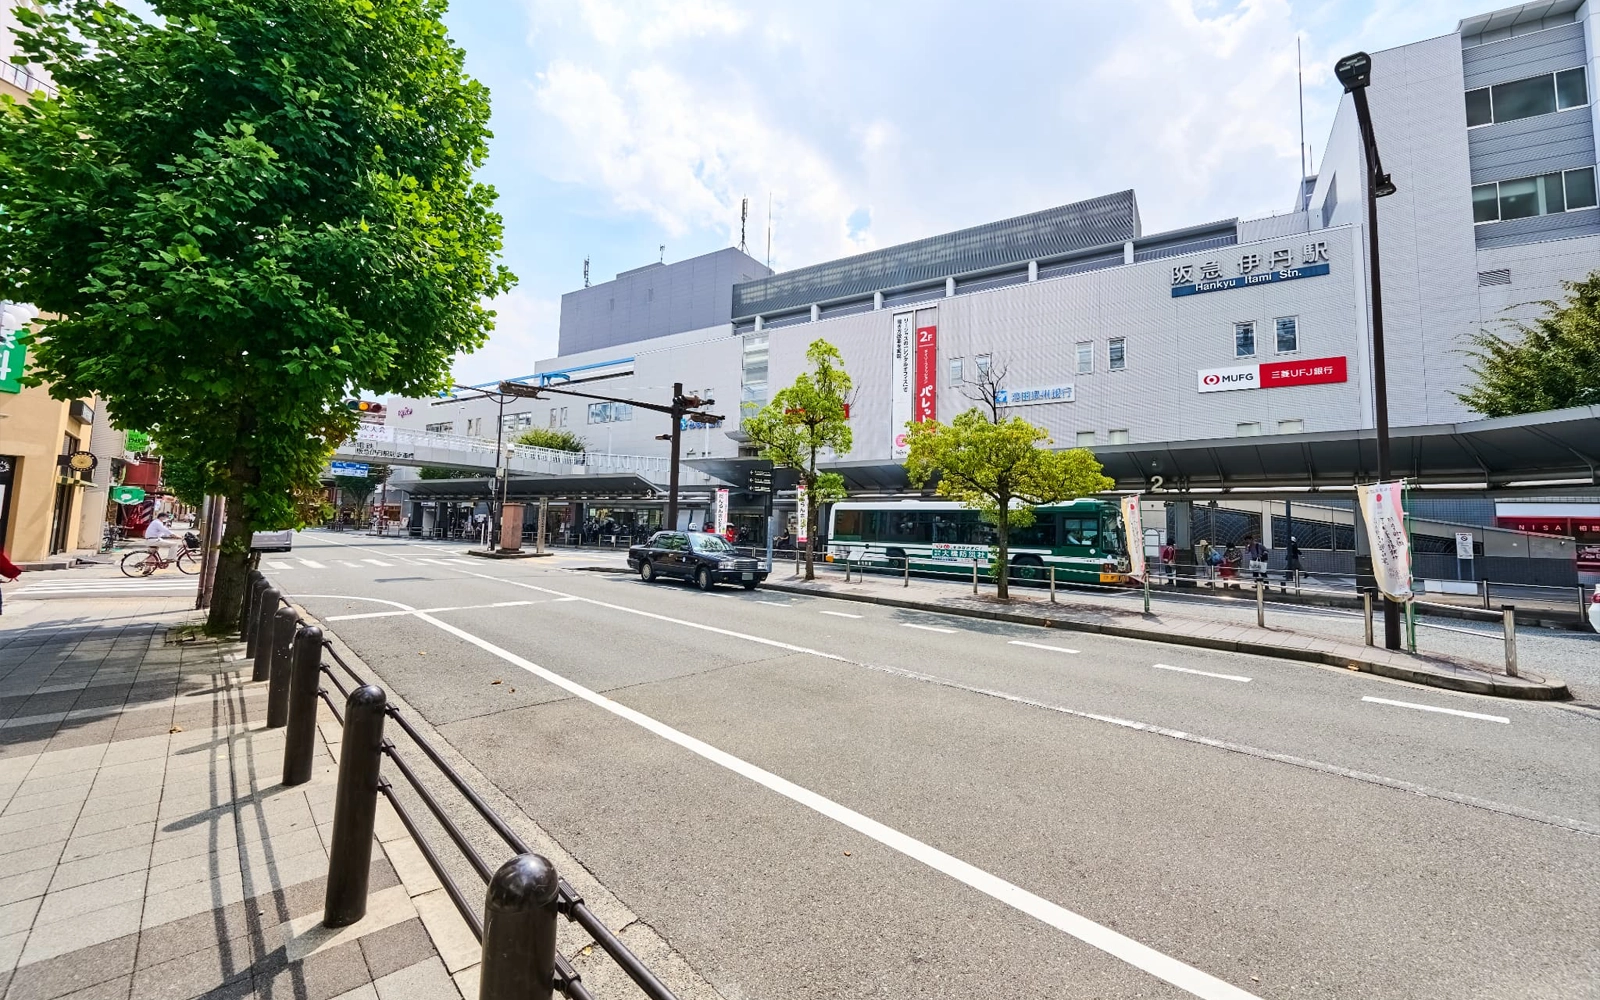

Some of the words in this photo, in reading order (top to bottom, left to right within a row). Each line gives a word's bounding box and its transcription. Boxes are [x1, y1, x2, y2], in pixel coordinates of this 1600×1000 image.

[1195, 278, 1236, 292] Hankyu
[1245, 272, 1272, 284] Itami
[1279, 268, 1302, 279] Stn.
[919, 330, 933, 343] 2F
[1221, 372, 1254, 383] MUFG
[1271, 365, 1334, 379] 三菱UFJ銀行
[1150, 475, 1164, 492] 2
